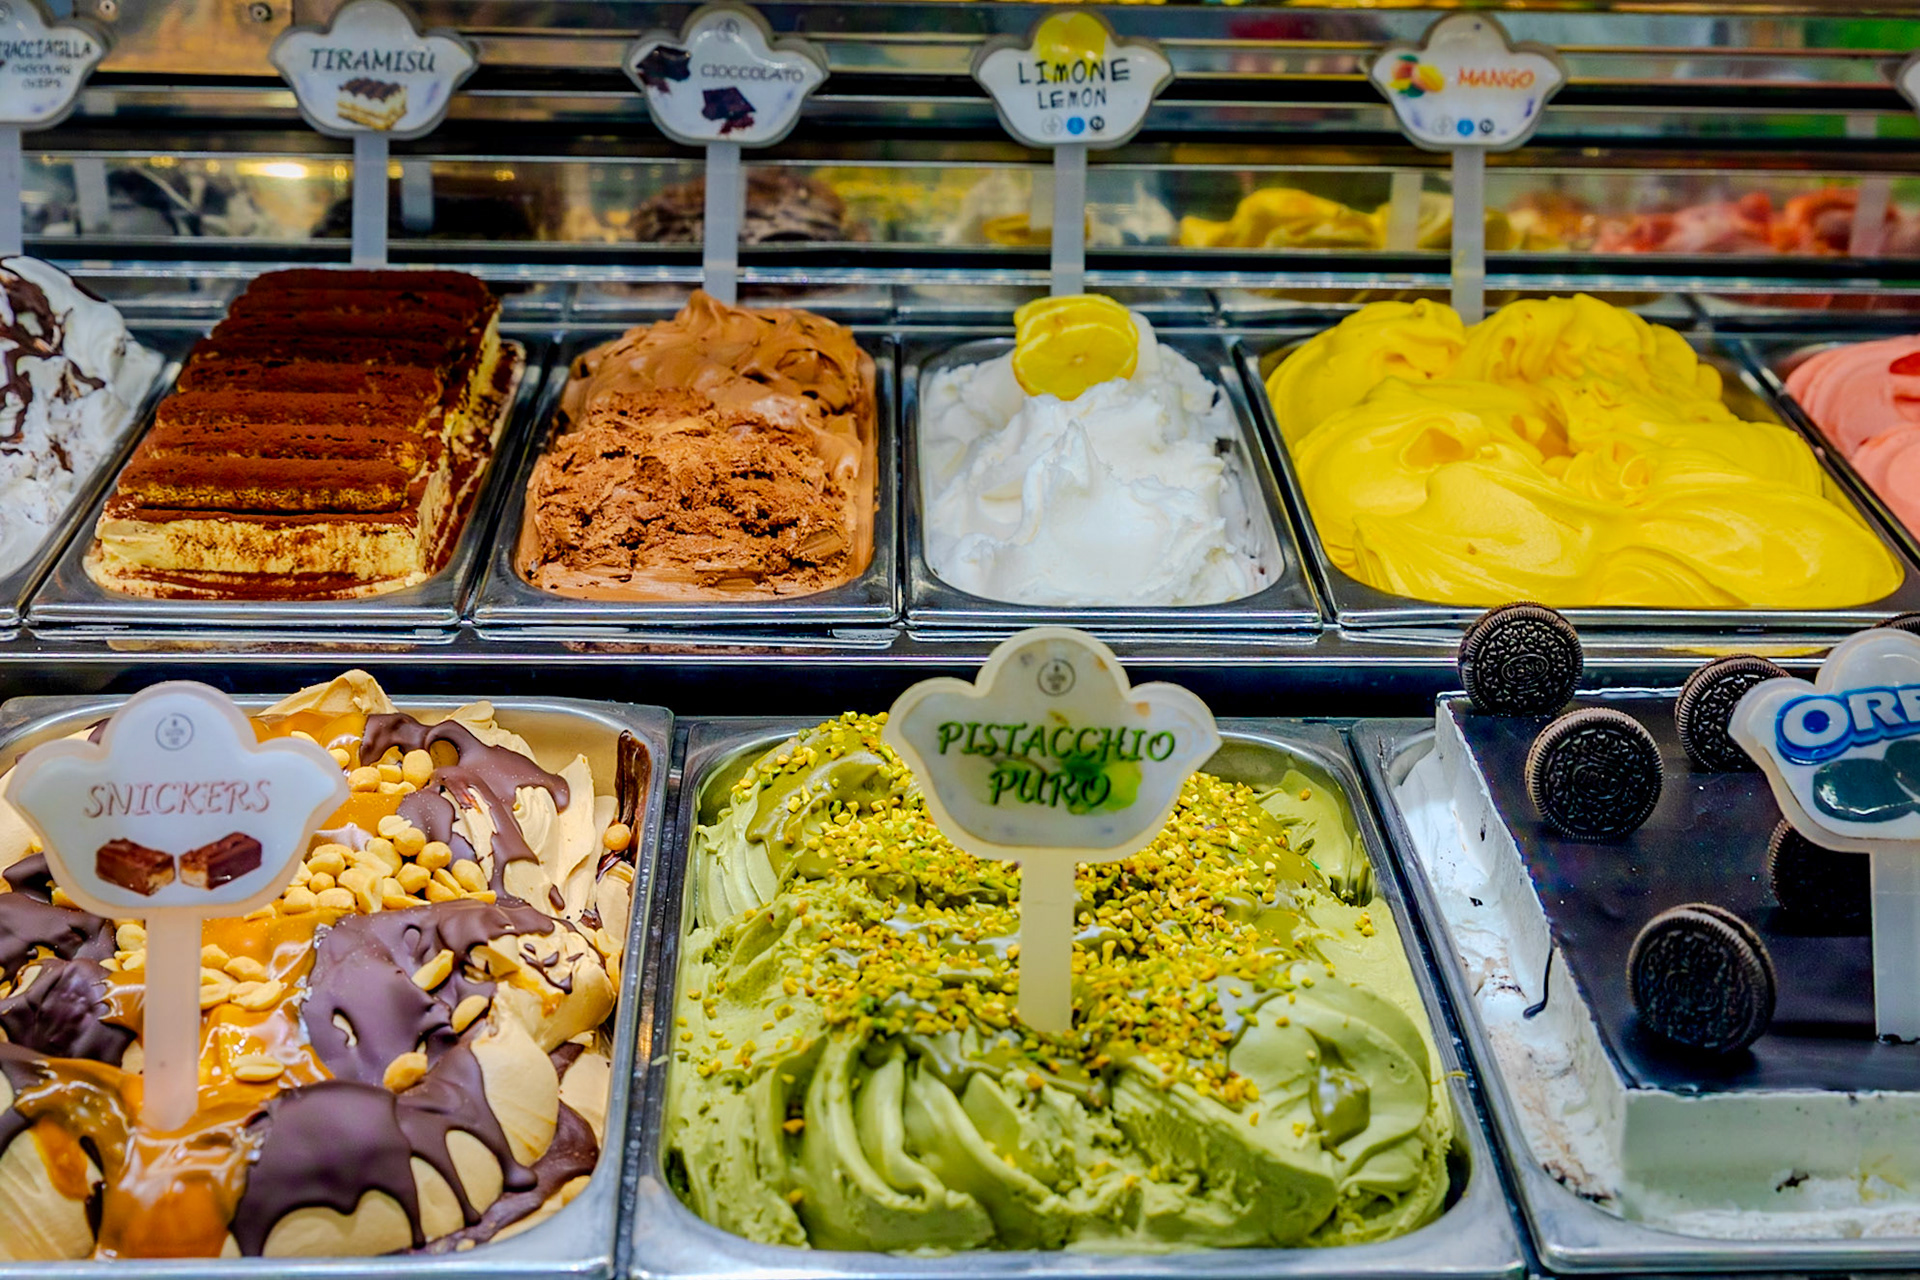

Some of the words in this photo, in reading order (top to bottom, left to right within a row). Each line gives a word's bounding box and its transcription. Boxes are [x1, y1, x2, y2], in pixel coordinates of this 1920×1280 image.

[0, 39, 92, 59] RACCIATELLA
[701, 64, 804, 83] CIOCCOLATO
[1018, 58, 1130, 85] LIMONE
[1458, 66, 1535, 89] MANGO
[1038, 88, 1106, 110] LEMON
[937, 721, 1176, 762] PISTACCHIO
[84, 780, 272, 818] SNICKERS
[989, 768, 1111, 807] PURO
